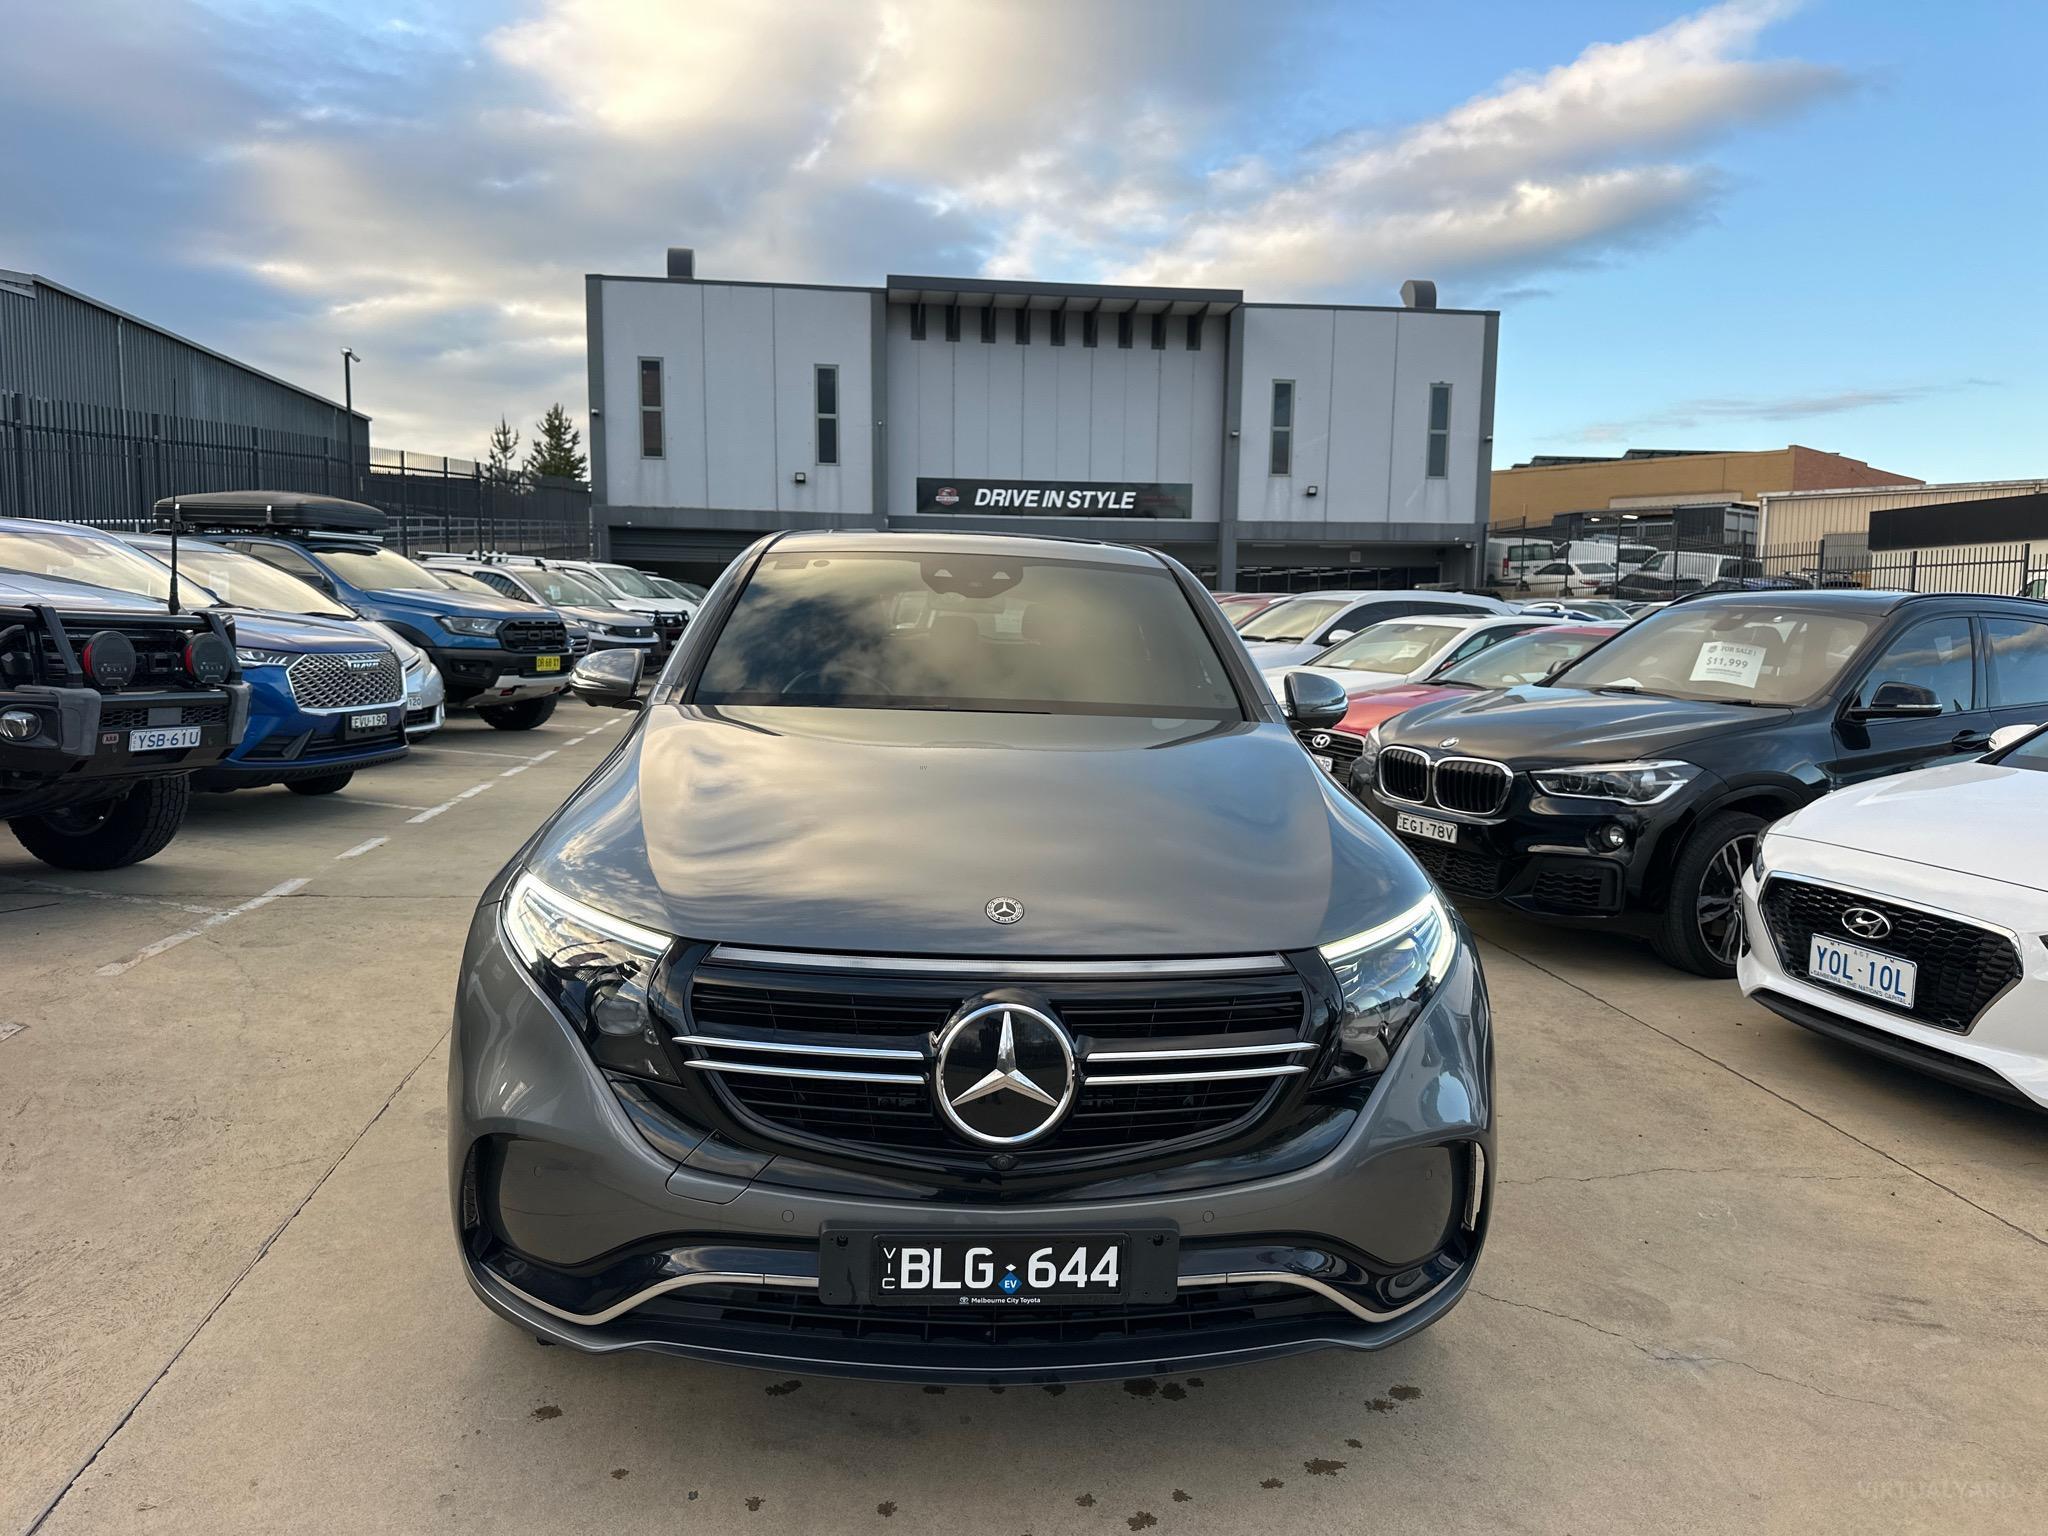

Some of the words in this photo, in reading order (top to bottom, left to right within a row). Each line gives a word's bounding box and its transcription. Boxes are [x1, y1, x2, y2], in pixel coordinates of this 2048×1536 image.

[974, 487, 1041, 508] DRIVE
[1041, 489, 1064, 508] IN
[1066, 489, 1137, 510] STYLE
[509, 629, 565, 640] FORD
[1706, 656, 1749, 669] $11,999
[881, 1247, 897, 1290] VIC
[1004, 1279, 1018, 1289] EV
[971, 1296, 1006, 1304] Melbourne
[1006, 1296, 1020, 1305] City
[1020, 1296, 1041, 1305] Toyota
